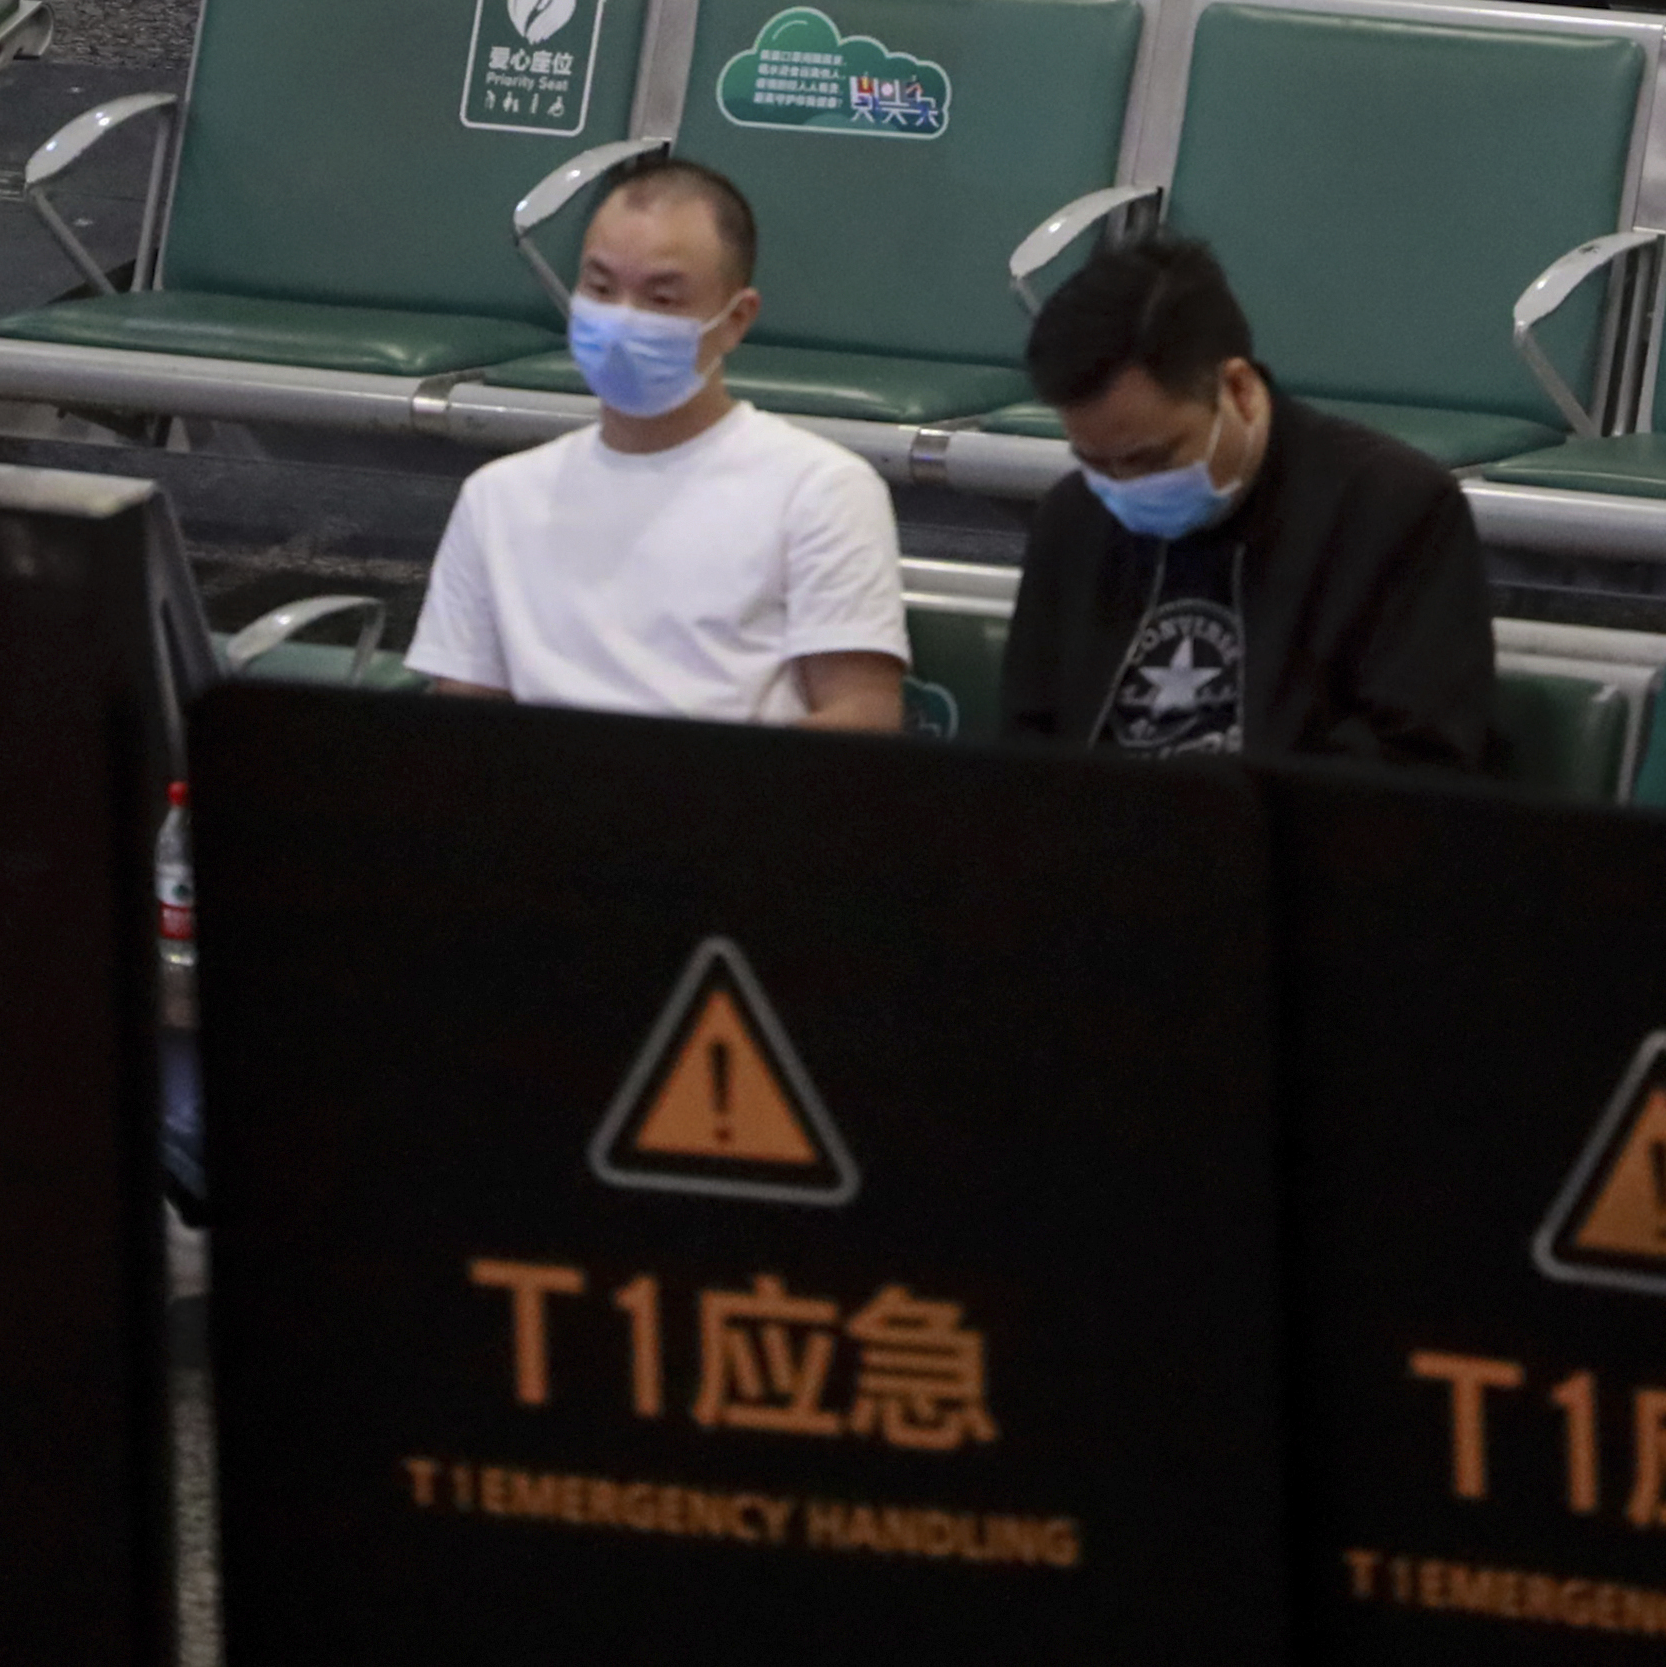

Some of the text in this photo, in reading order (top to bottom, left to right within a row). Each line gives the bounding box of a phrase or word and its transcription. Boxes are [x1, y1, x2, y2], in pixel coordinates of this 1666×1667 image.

[486, 71, 569, 92] Priority Seat
[489, 46, 574, 76] 爱心座位
[467, 1256, 1003, 1452] T1应急
[479, 1462, 795, 1545] EMERGENCY
[805, 1498, 1085, 1570] HANDLING
